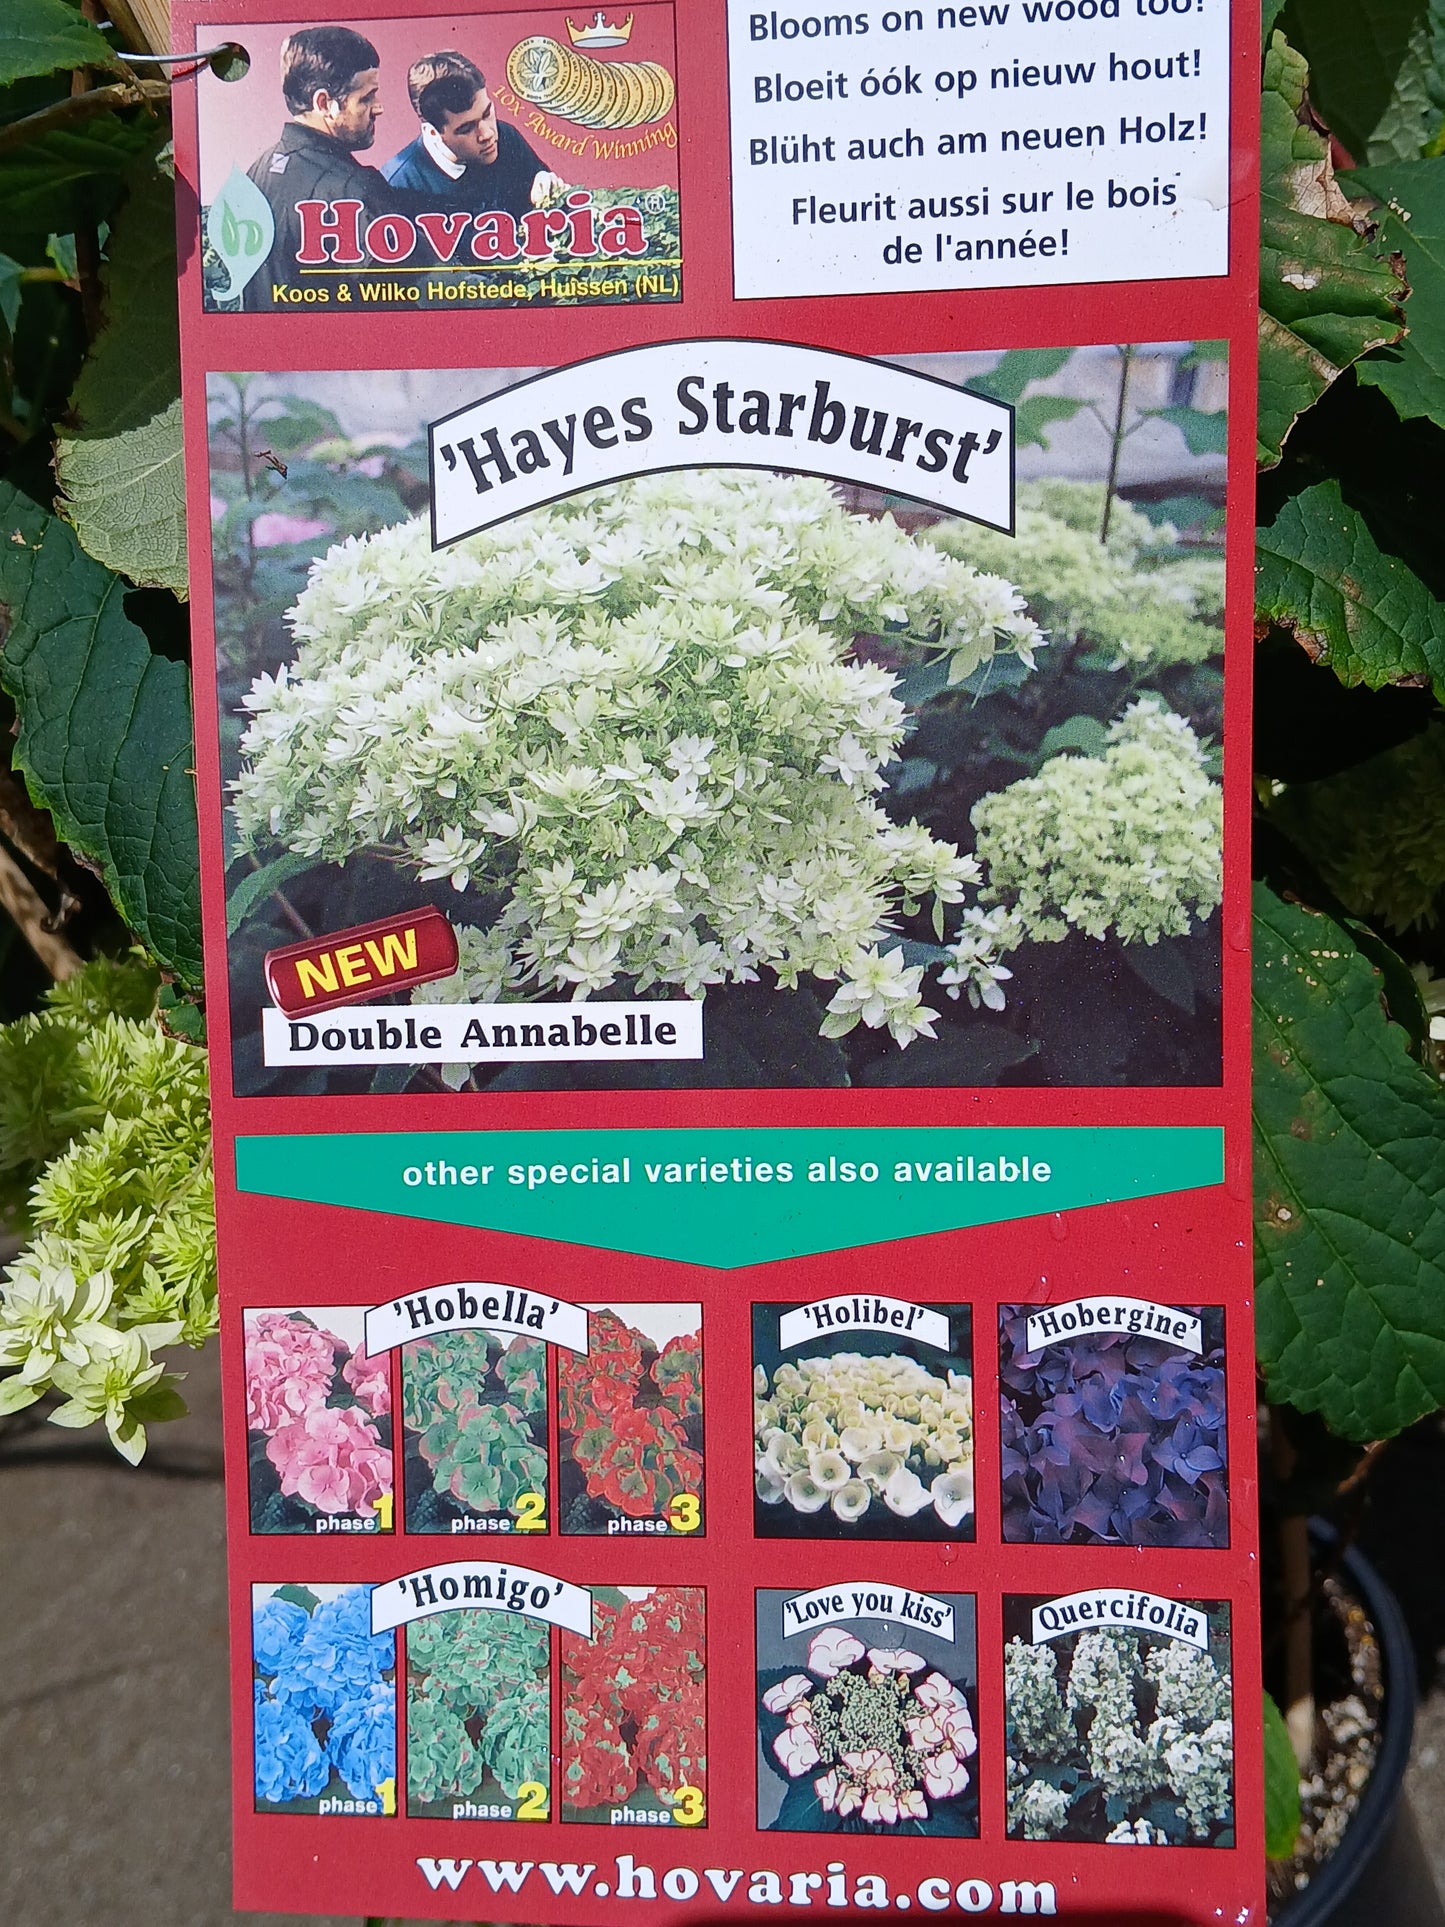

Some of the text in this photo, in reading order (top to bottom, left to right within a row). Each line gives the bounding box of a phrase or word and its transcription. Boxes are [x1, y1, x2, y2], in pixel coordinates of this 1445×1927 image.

[750, 9, 869, 41] Blooms
[882, 7, 924, 32] on
[937, 1, 1009, 29] new
[1024, 0, 1120, 23] wood
[754, 49, 1202, 103] Bloeit óók op nieuw hout!
[524, 111, 594, 157] Award
[592, 121, 678, 160] Winning
[750, 112, 1208, 165] Blüht auch am neuen Holz!
[792, 177, 1177, 225] Fleurit aussi sur le bois
[295, 190, 647, 265] Hovaria
[883, 228, 1069, 265] de l'année!
[273, 273, 679, 304] Koos & Wilko Hofstede, Huissen (NL)
[294, 927, 419, 998] NEW
[289, 1014, 677, 1052] Double Annabelle
[402, 1155, 1052, 1190] other special varieties also available
[316, 1493, 393, 1533] phase 1
[451, 1493, 546, 1533] phase 2
[608, 1494, 701, 1535] phase 3
[850, 1591, 893, 1615] you
[1038, 1598, 1200, 1637] Quercifolia
[319, 1778, 396, 1816] phase 1
[453, 1782, 548, 1820] phase 2
[610, 1786, 705, 1824] phase 3
[416, 1855, 1058, 1915] www.hovaria.com
